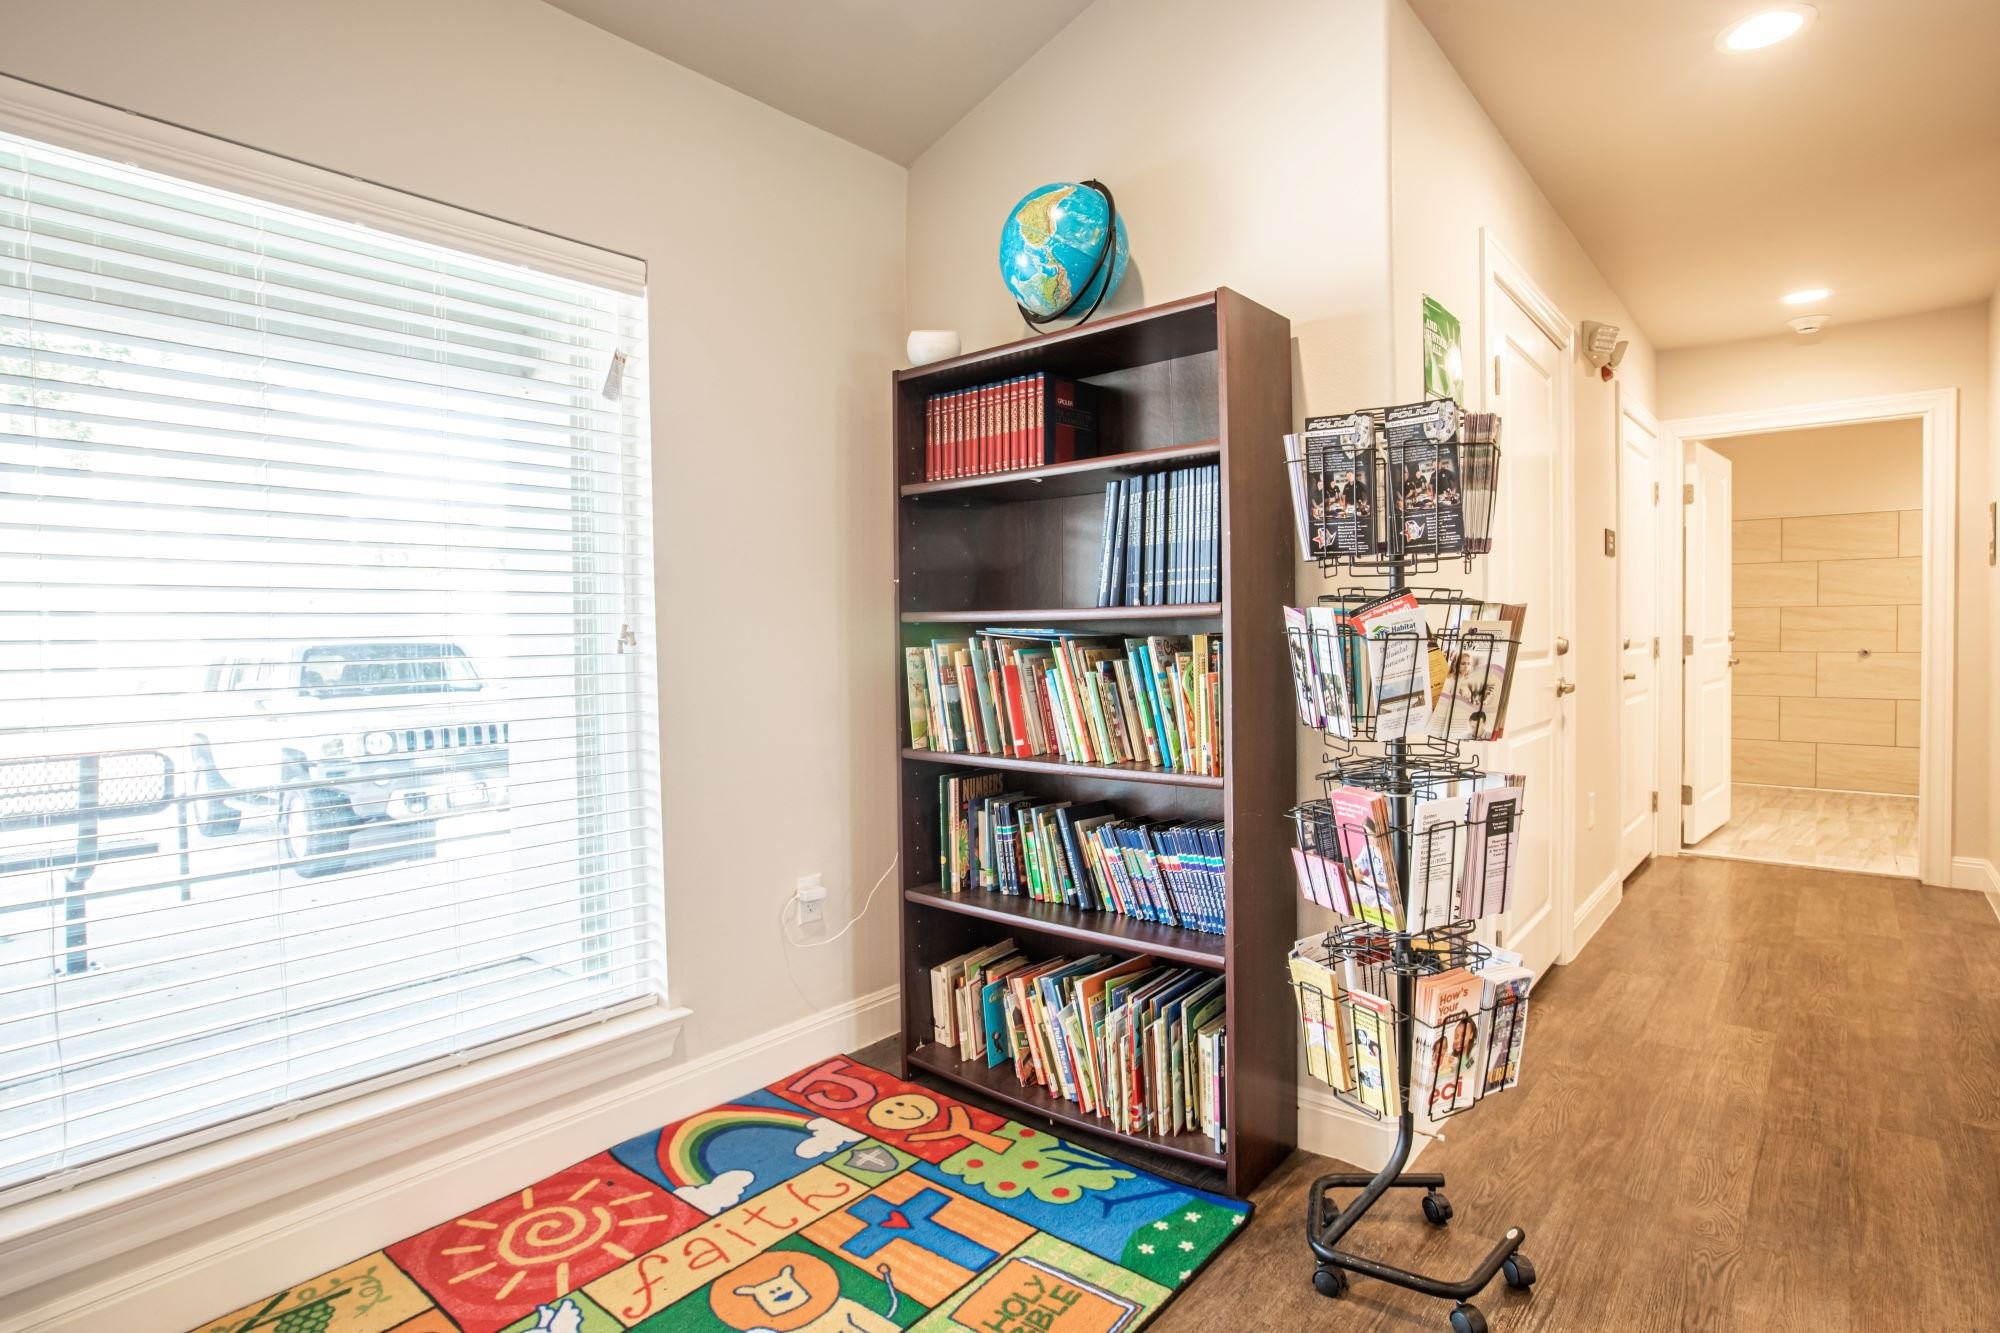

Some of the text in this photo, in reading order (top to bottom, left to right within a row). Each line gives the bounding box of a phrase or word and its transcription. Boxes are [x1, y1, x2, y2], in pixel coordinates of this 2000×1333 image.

[1391, 622, 1416, 634] Habitat
[1439, 987, 1469, 1006] How's
[1438, 1002, 1460, 1017] Your
[1053, 1026, 1065, 1050] Polar
[1428, 1077, 1463, 1106] eci
[621, 1180, 852, 1320] faith
[981, 1274, 1046, 1333] HOLY
